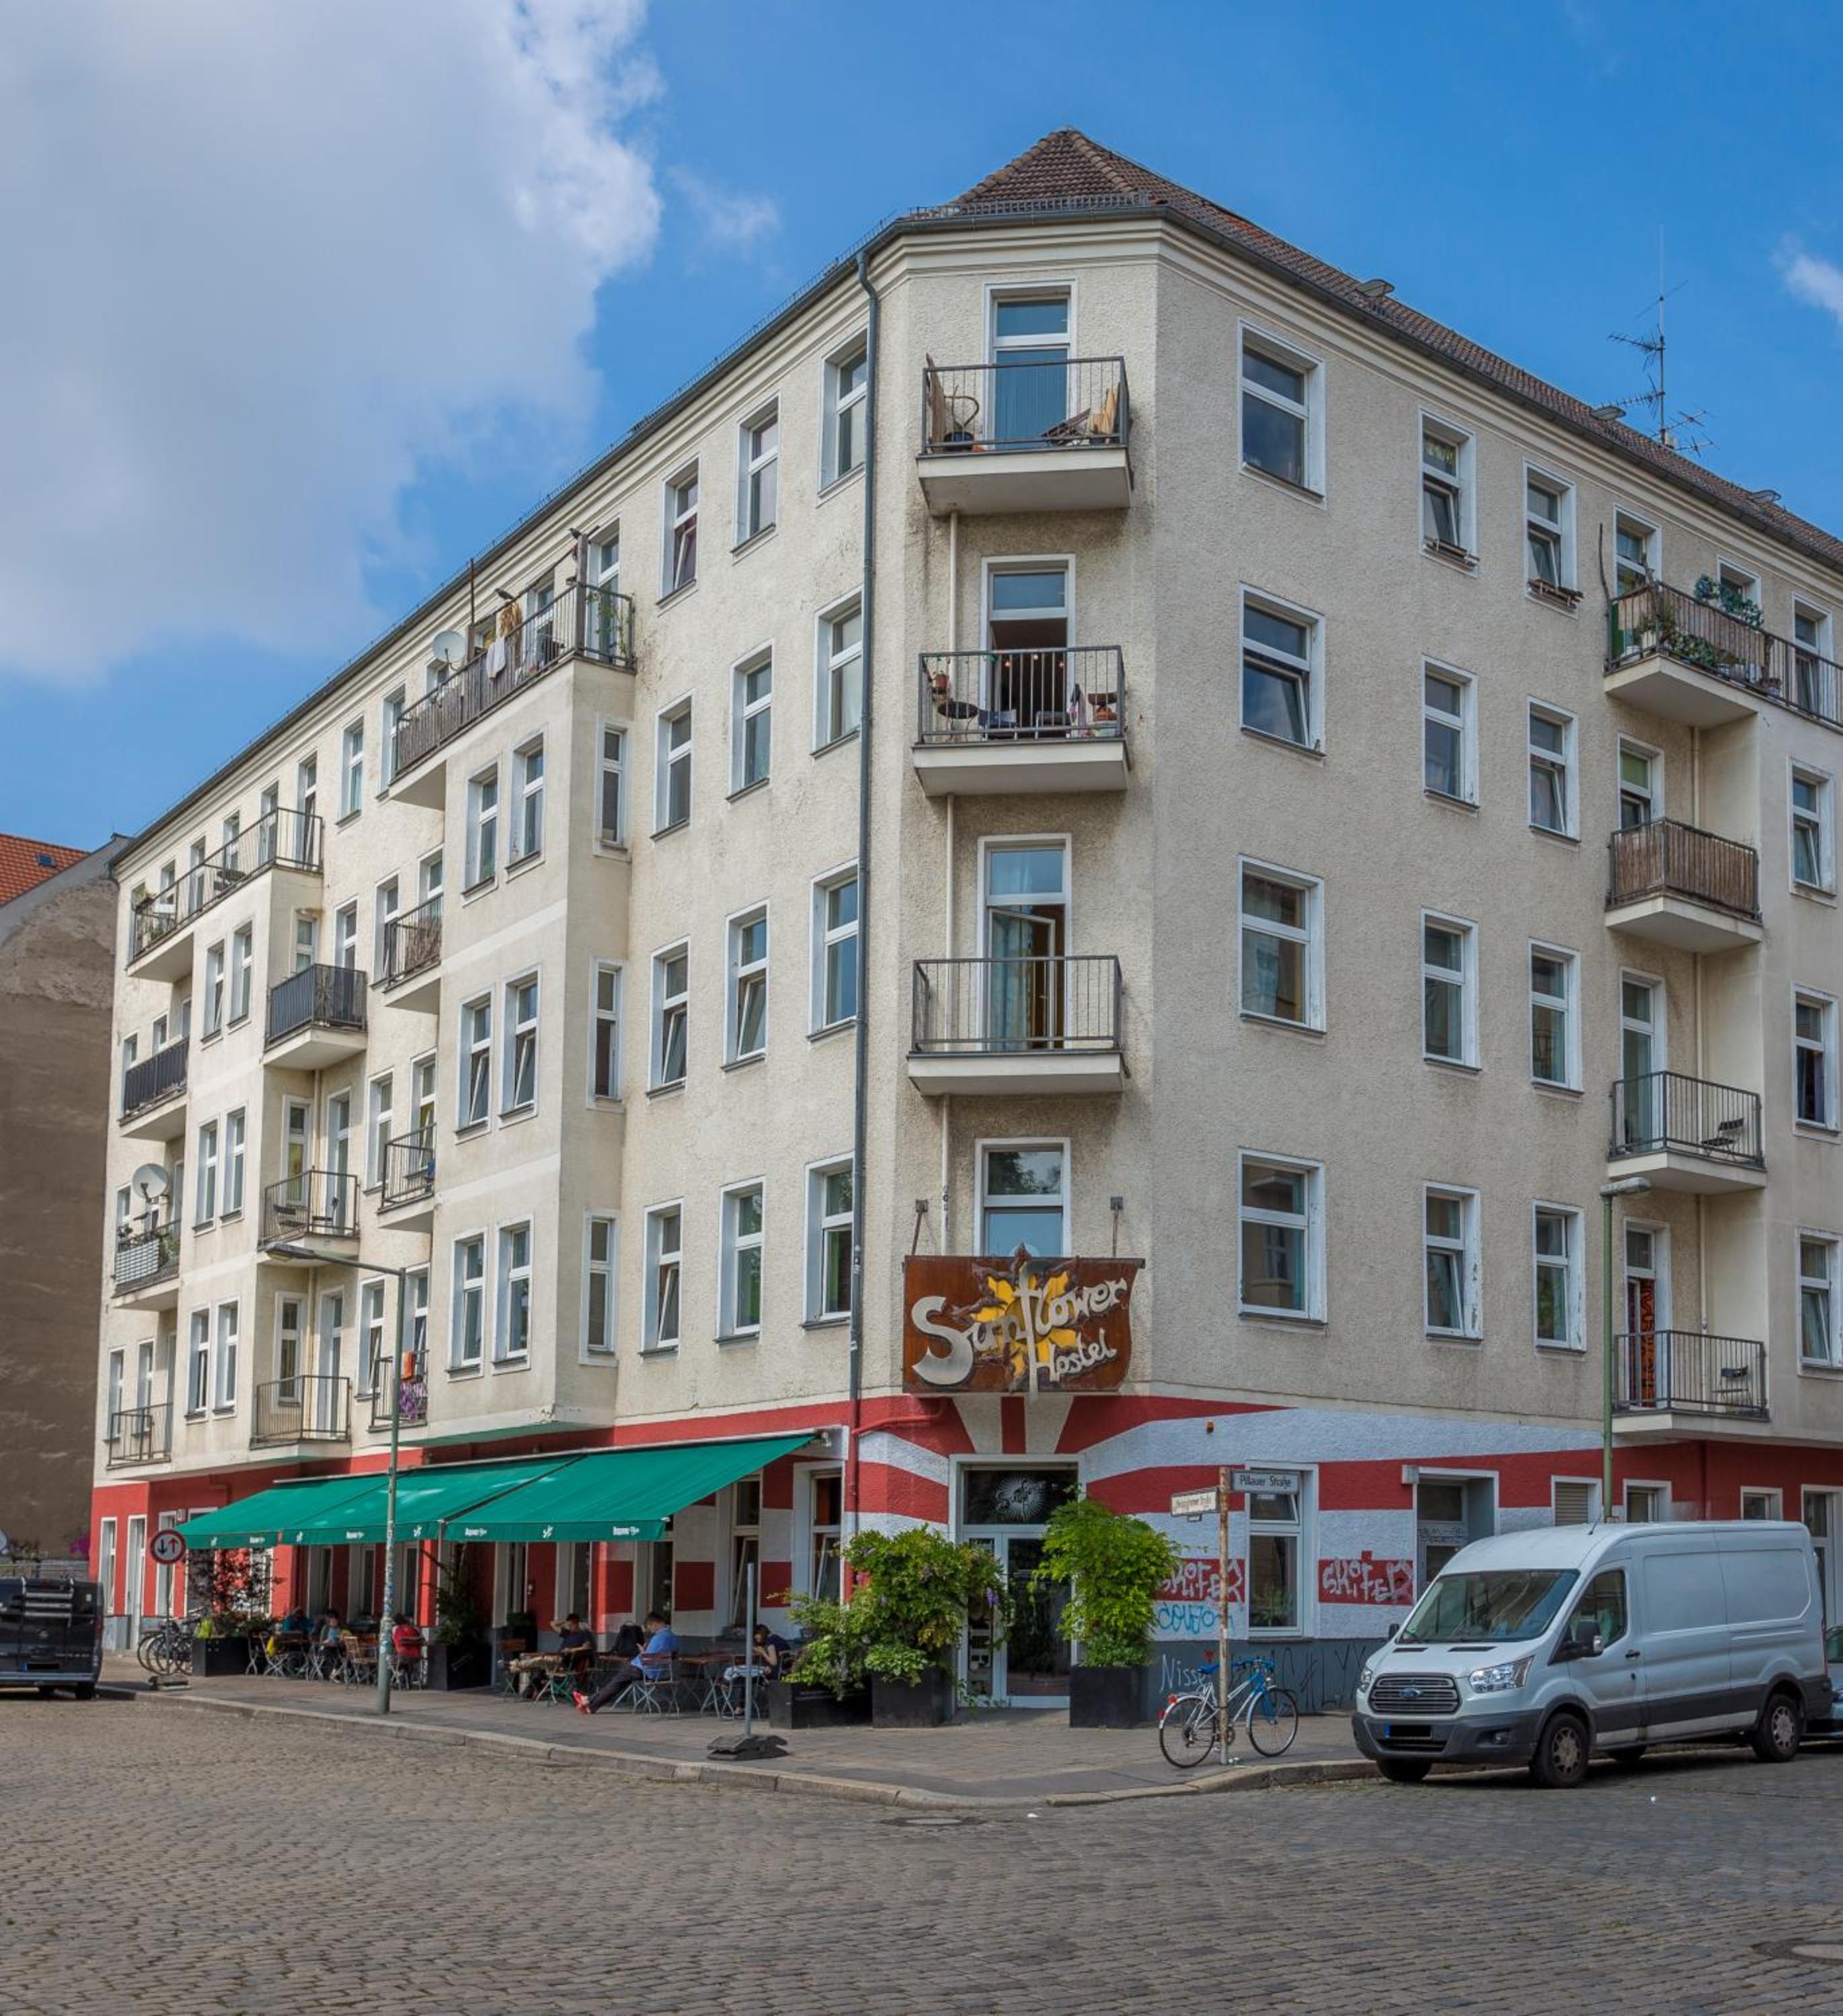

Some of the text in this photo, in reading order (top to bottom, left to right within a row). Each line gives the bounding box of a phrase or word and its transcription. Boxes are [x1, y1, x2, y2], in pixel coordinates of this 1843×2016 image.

[911, 1269, 1127, 1390] Sunflower
[1029, 1329, 1116, 1386] Hostel
[1240, 1474, 1292, 1490] Pillauer Straße
